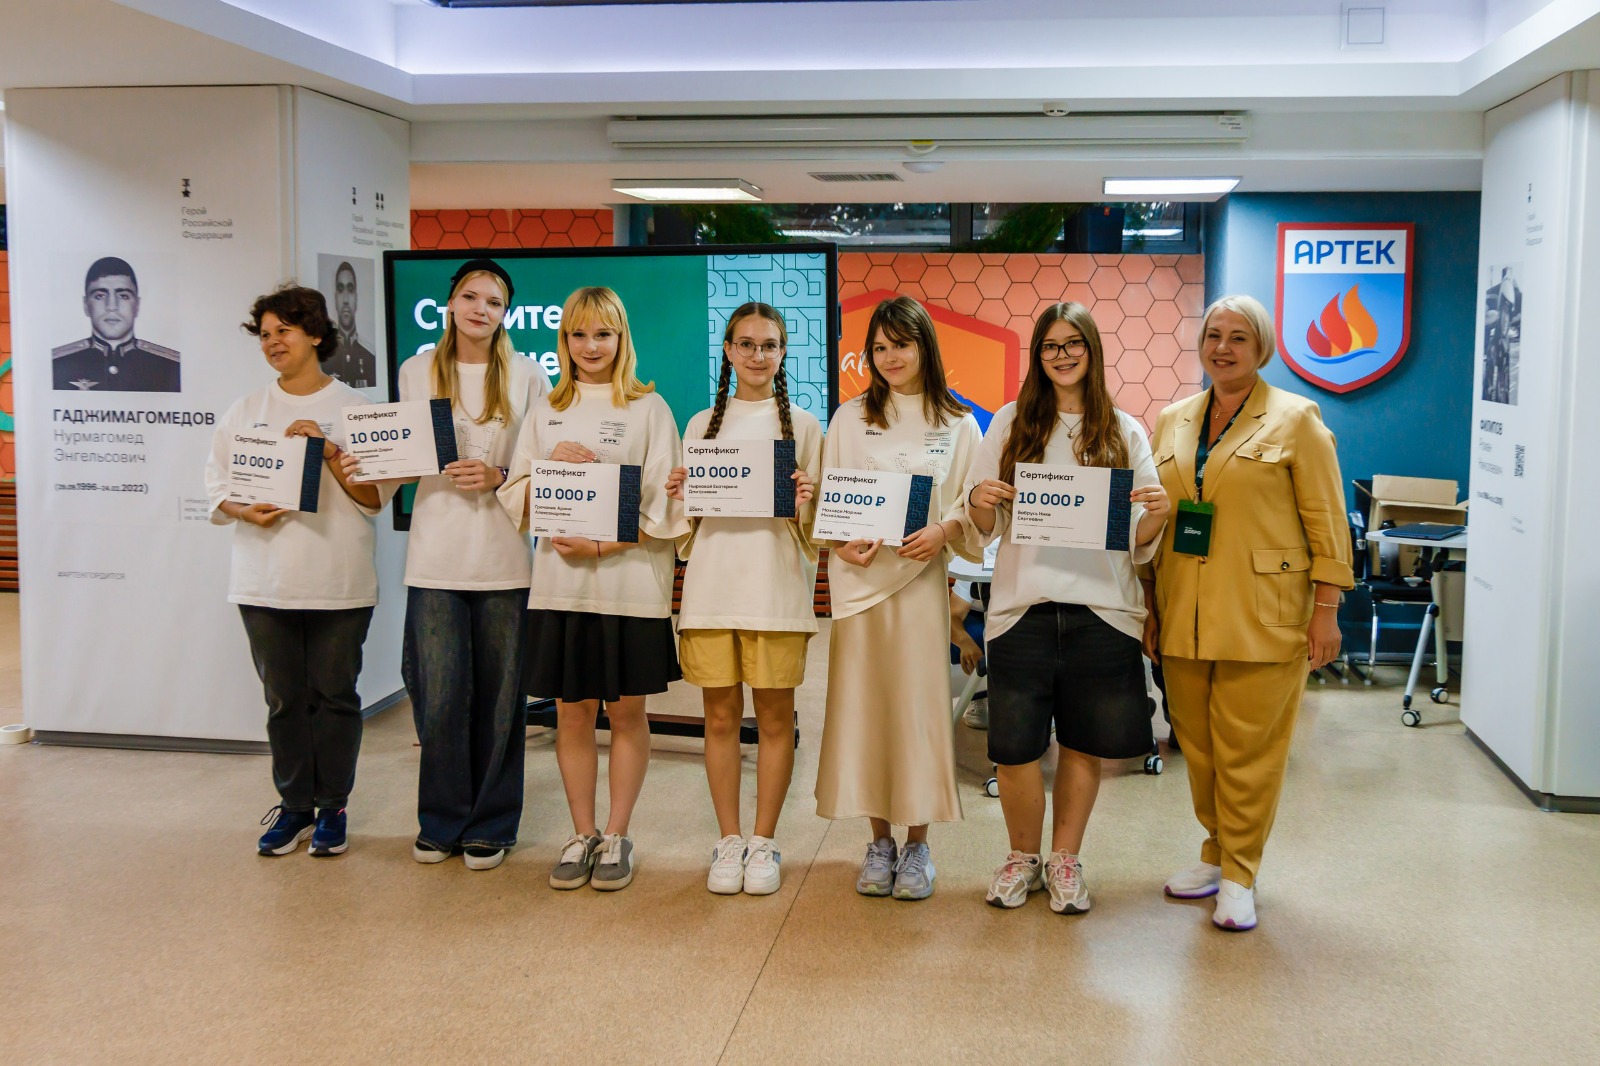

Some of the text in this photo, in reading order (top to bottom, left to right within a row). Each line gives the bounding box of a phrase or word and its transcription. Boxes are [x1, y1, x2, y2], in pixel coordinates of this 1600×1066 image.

[181, 206, 207, 216] Герой
[1294, 240, 1396, 265] АРТЕК
[53, 409, 216, 427] ГАДЖИМАГОМЕДОВ
[347, 411, 398, 421] Сертификат
[54, 429, 144, 446] Нурмагомед
[234, 434, 277, 446] Сертификат
[350, 432, 367, 444] 10
[370, 429, 399, 442] 000
[54, 448, 146, 463] Энгельсович
[687, 446, 740, 455] Сертификат
[232, 454, 247, 465] 10
[249, 456, 273, 469] 000
[535, 467, 586, 477] Сертификат
[688, 466, 705, 478] 10
[709, 466, 738, 478] 000
[827, 474, 878, 484] Сертификат
[1020, 471, 1075, 482] Сертификат
[535, 487, 551, 499] 10
[555, 488, 583, 501] 000
[823, 491, 841, 503] 10
[843, 493, 873, 506] 000
[1018, 491, 1037, 505] 10
[1040, 493, 1071, 507] 000
